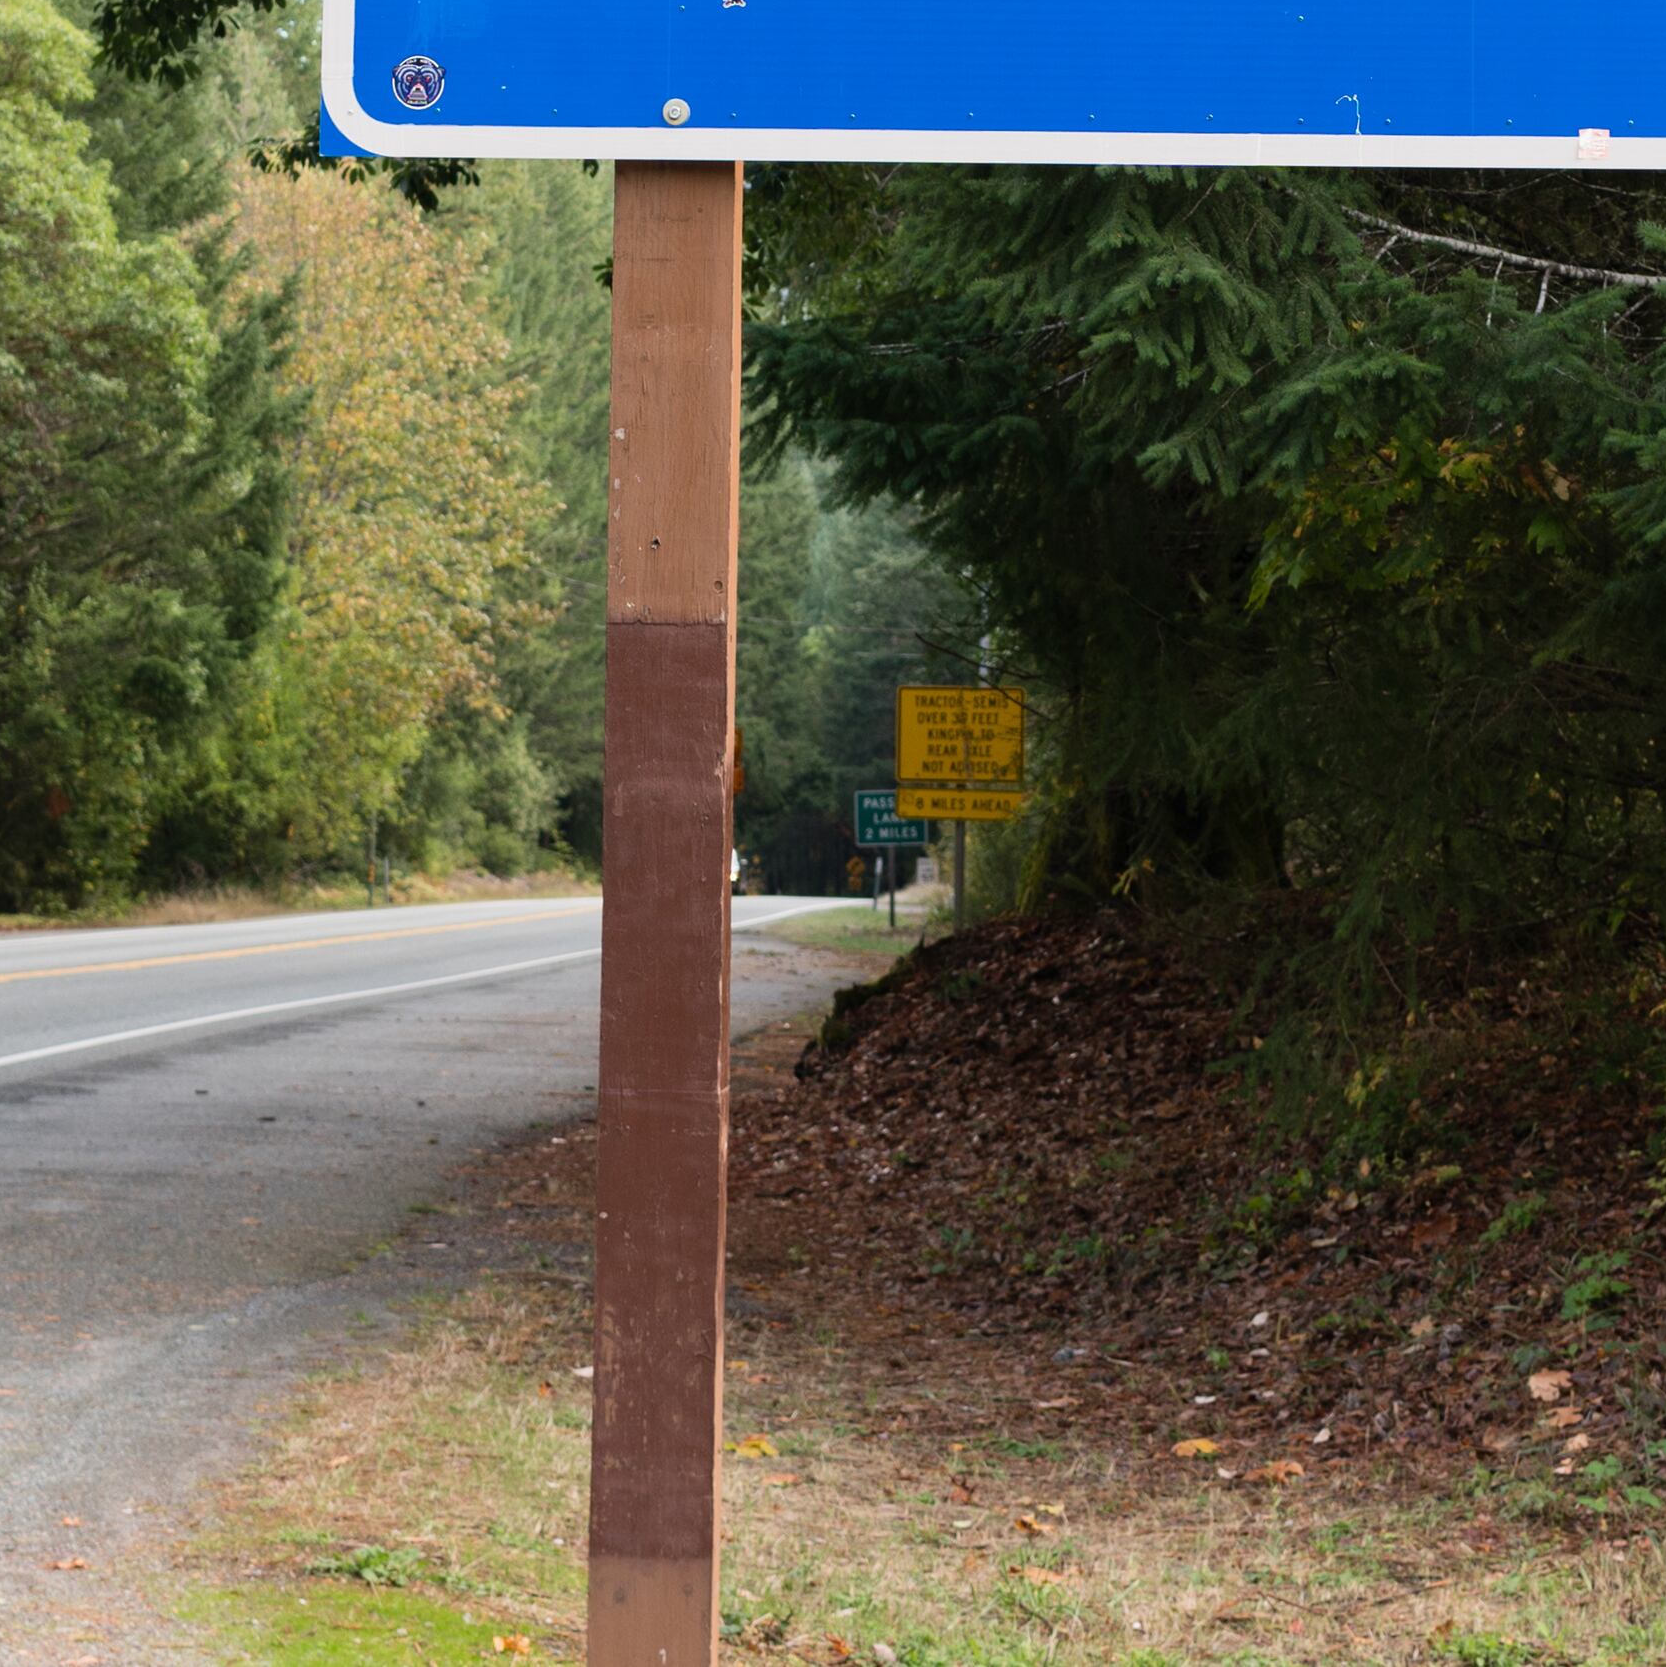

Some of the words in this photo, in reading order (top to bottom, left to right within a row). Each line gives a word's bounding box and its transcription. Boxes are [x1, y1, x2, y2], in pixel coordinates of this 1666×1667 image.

[917, 711, 948, 725] OVER
[971, 712, 999, 726] FEET
[927, 744, 958, 757] REAR
[922, 760, 944, 773] NOT
[915, 798, 924, 810] 8
[930, 797, 966, 811] MILES
[971, 798, 1011, 812] AHEAD
[866, 828, 874, 839] 2
[878, 827, 917, 838] MILES
